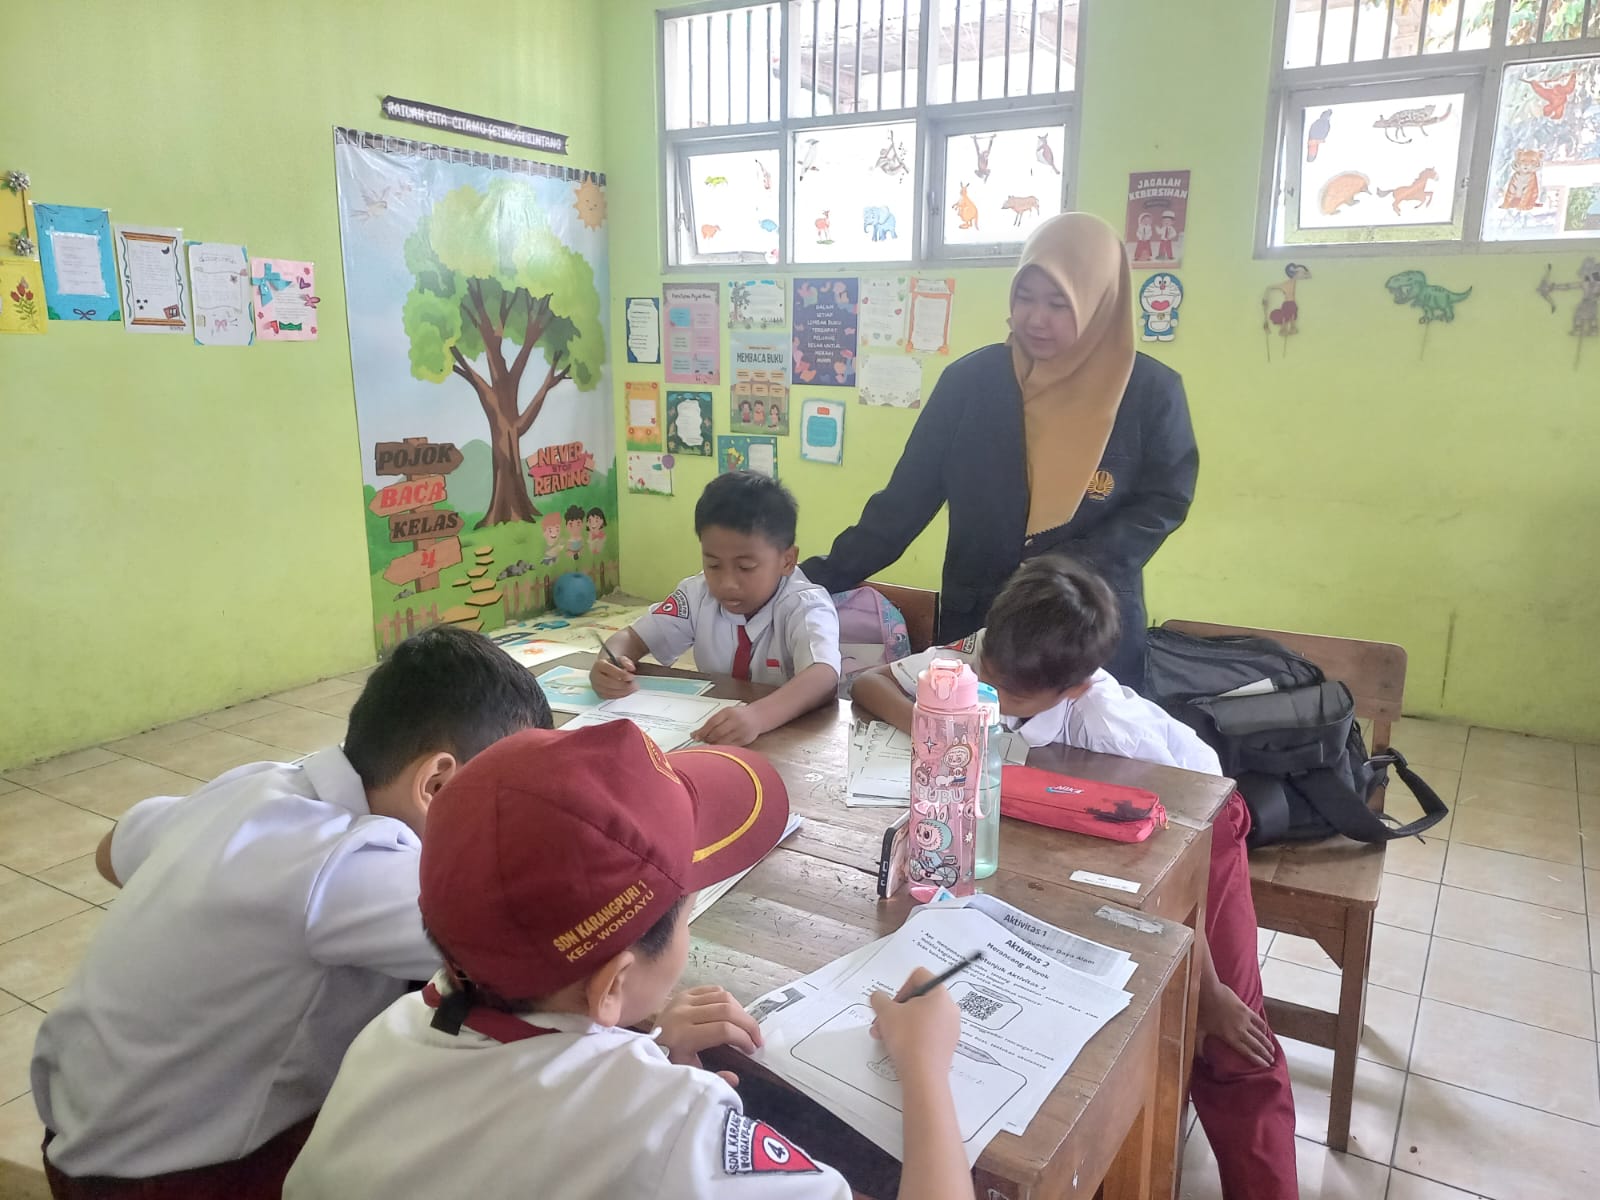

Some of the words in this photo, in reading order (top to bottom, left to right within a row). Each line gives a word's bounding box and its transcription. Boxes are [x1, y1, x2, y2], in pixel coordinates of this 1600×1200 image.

[1128, 187, 1188, 200] KEBERSIHAN
[1137, 177, 1181, 189] JAGALAH
[736, 352, 766, 363] MEMBACA
[766, 353, 784, 363] BUKU
[378, 445, 452, 471] POJOK
[537, 441, 583, 467] NEVER
[380, 481, 445, 508] BACA
[533, 469, 591, 496] READING
[391, 512, 459, 539] KELAS
[420, 549, 436, 568] 4
[918, 786, 965, 802] BUBU
[553, 930, 580, 952] SDN
[574, 884, 641, 939] KARANGPURI
[637, 879, 648, 889] 1
[566, 940, 598, 963] KEC.
[597, 889, 655, 940] WONOAYU
[1003, 913, 1042, 935] Aktivitas
[986, 942, 1025, 968] Merancang
[1005, 939, 1042, 965] Aktivitas
[1075, 955, 1096, 965] Alam
[980, 957, 1006, 974] etunjuk
[1007, 971, 1039, 987] Aktivitas
[728, 1150, 740, 1170] SDN
[766, 1140, 787, 1160] 4
